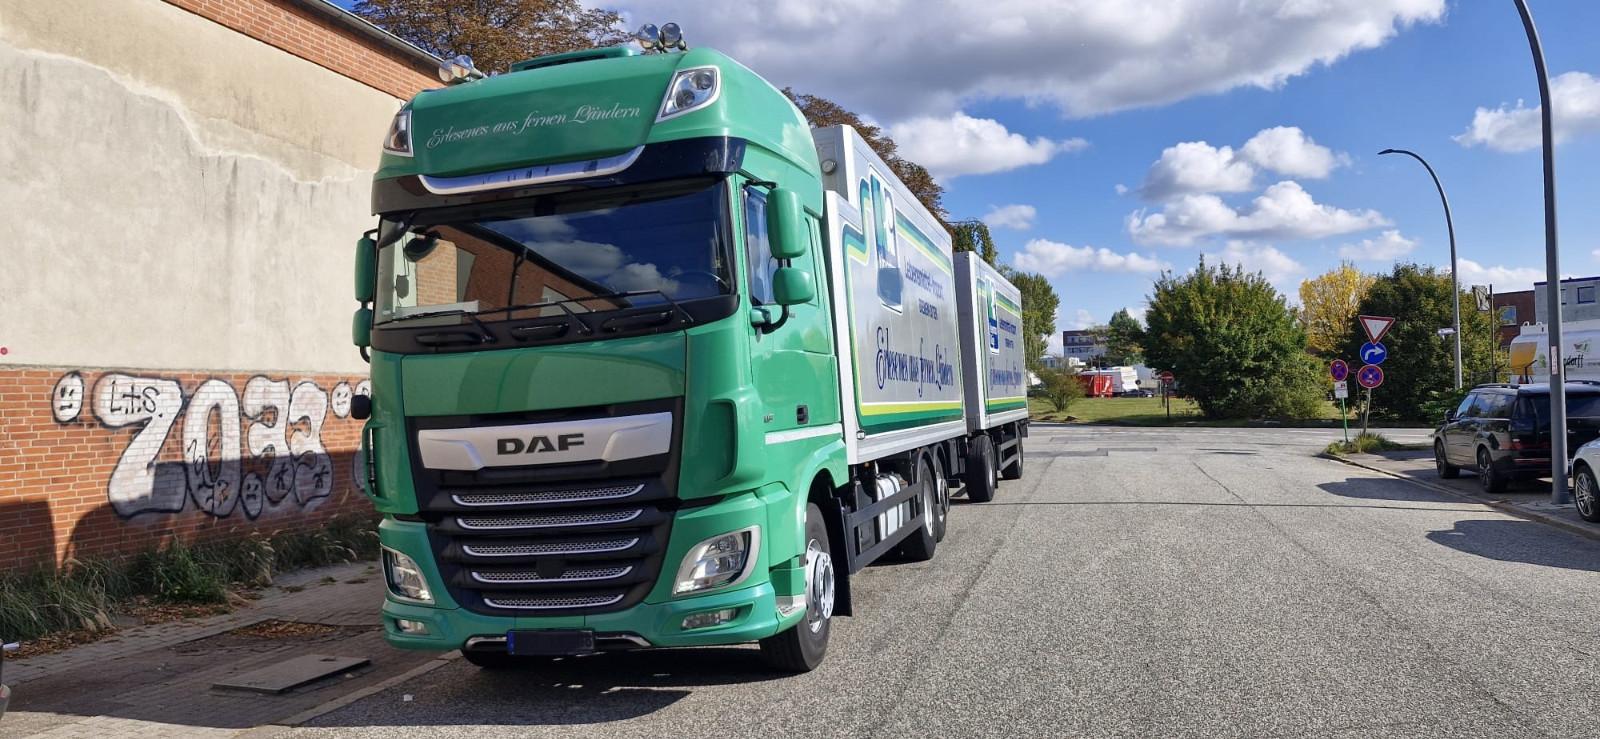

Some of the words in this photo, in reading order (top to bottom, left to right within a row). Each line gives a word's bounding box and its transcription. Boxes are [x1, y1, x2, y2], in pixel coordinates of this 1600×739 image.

[426, 125, 488, 149] Erlesenes
[493, 121, 517, 134] aus
[516, 110, 566, 135] fernen
[569, 103, 641, 125] Ländern
[497, 432, 585, 456] DAF
